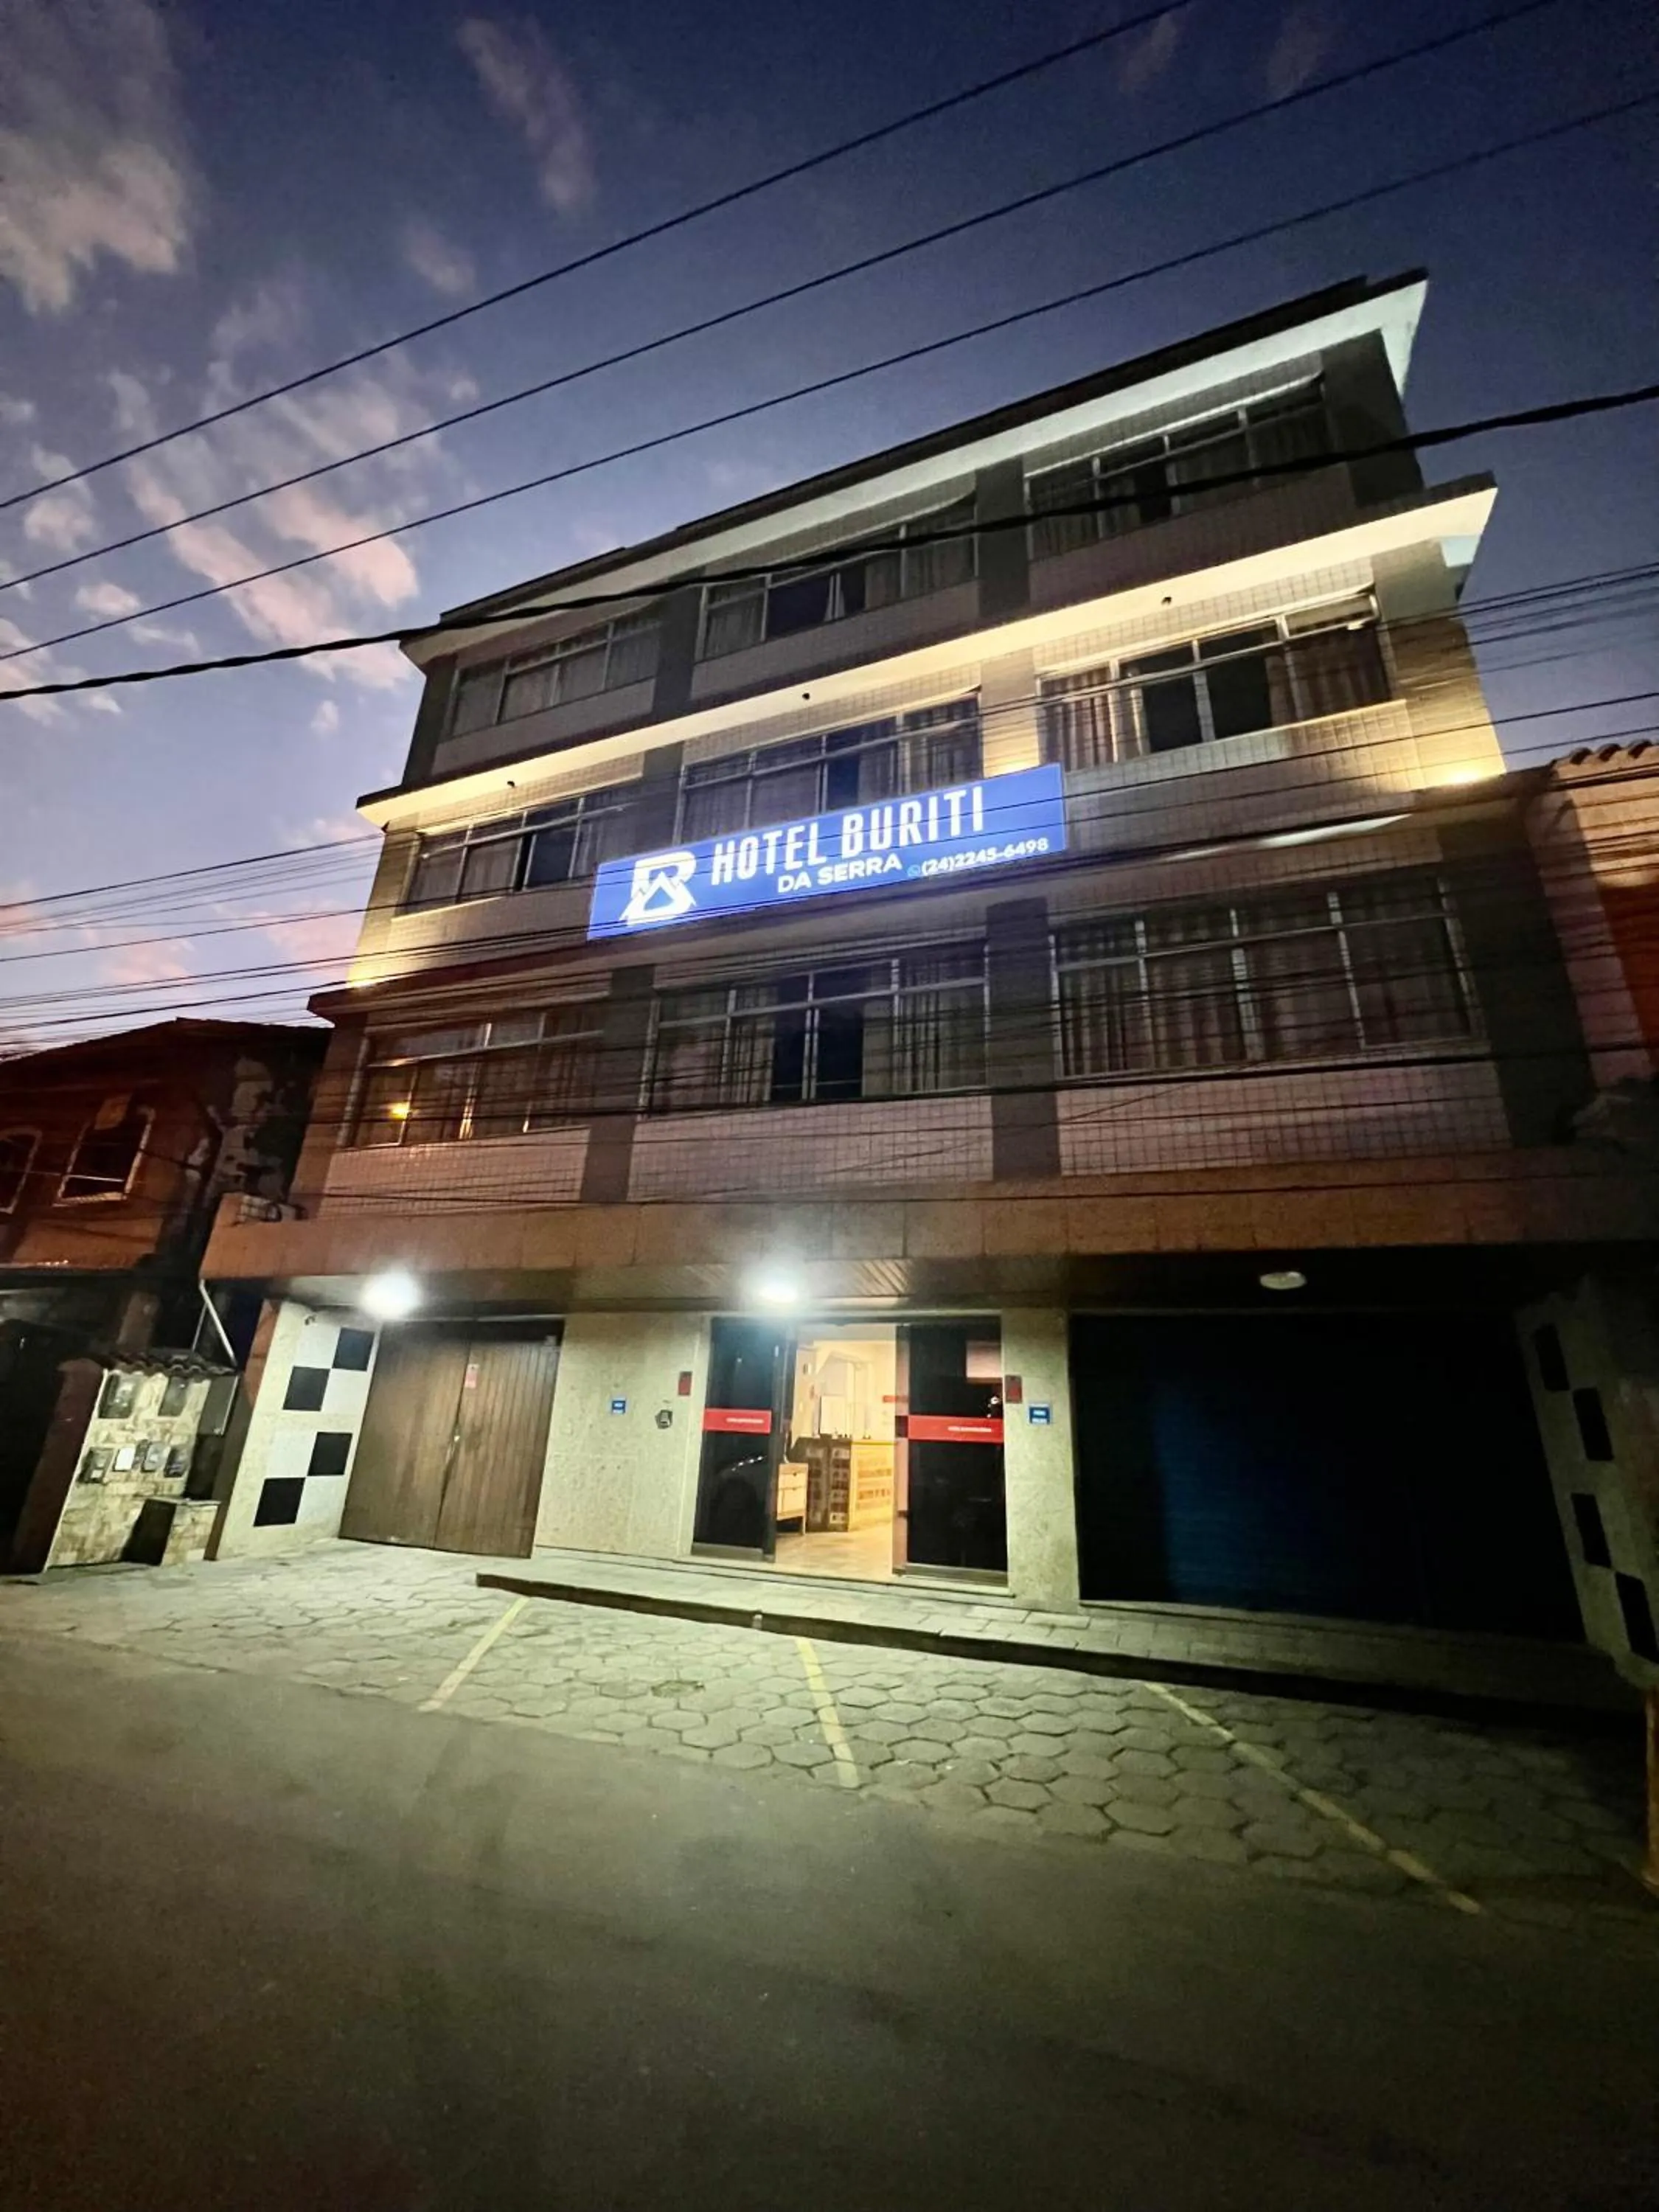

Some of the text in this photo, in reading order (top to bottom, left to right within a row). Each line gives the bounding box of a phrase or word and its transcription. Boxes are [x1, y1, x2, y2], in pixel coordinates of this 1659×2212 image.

[711, 786, 984, 886] HOTEL BURITI
[777, 852, 902, 894] DA SERRA
[921, 838, 1049, 877] (24)2245-6498
